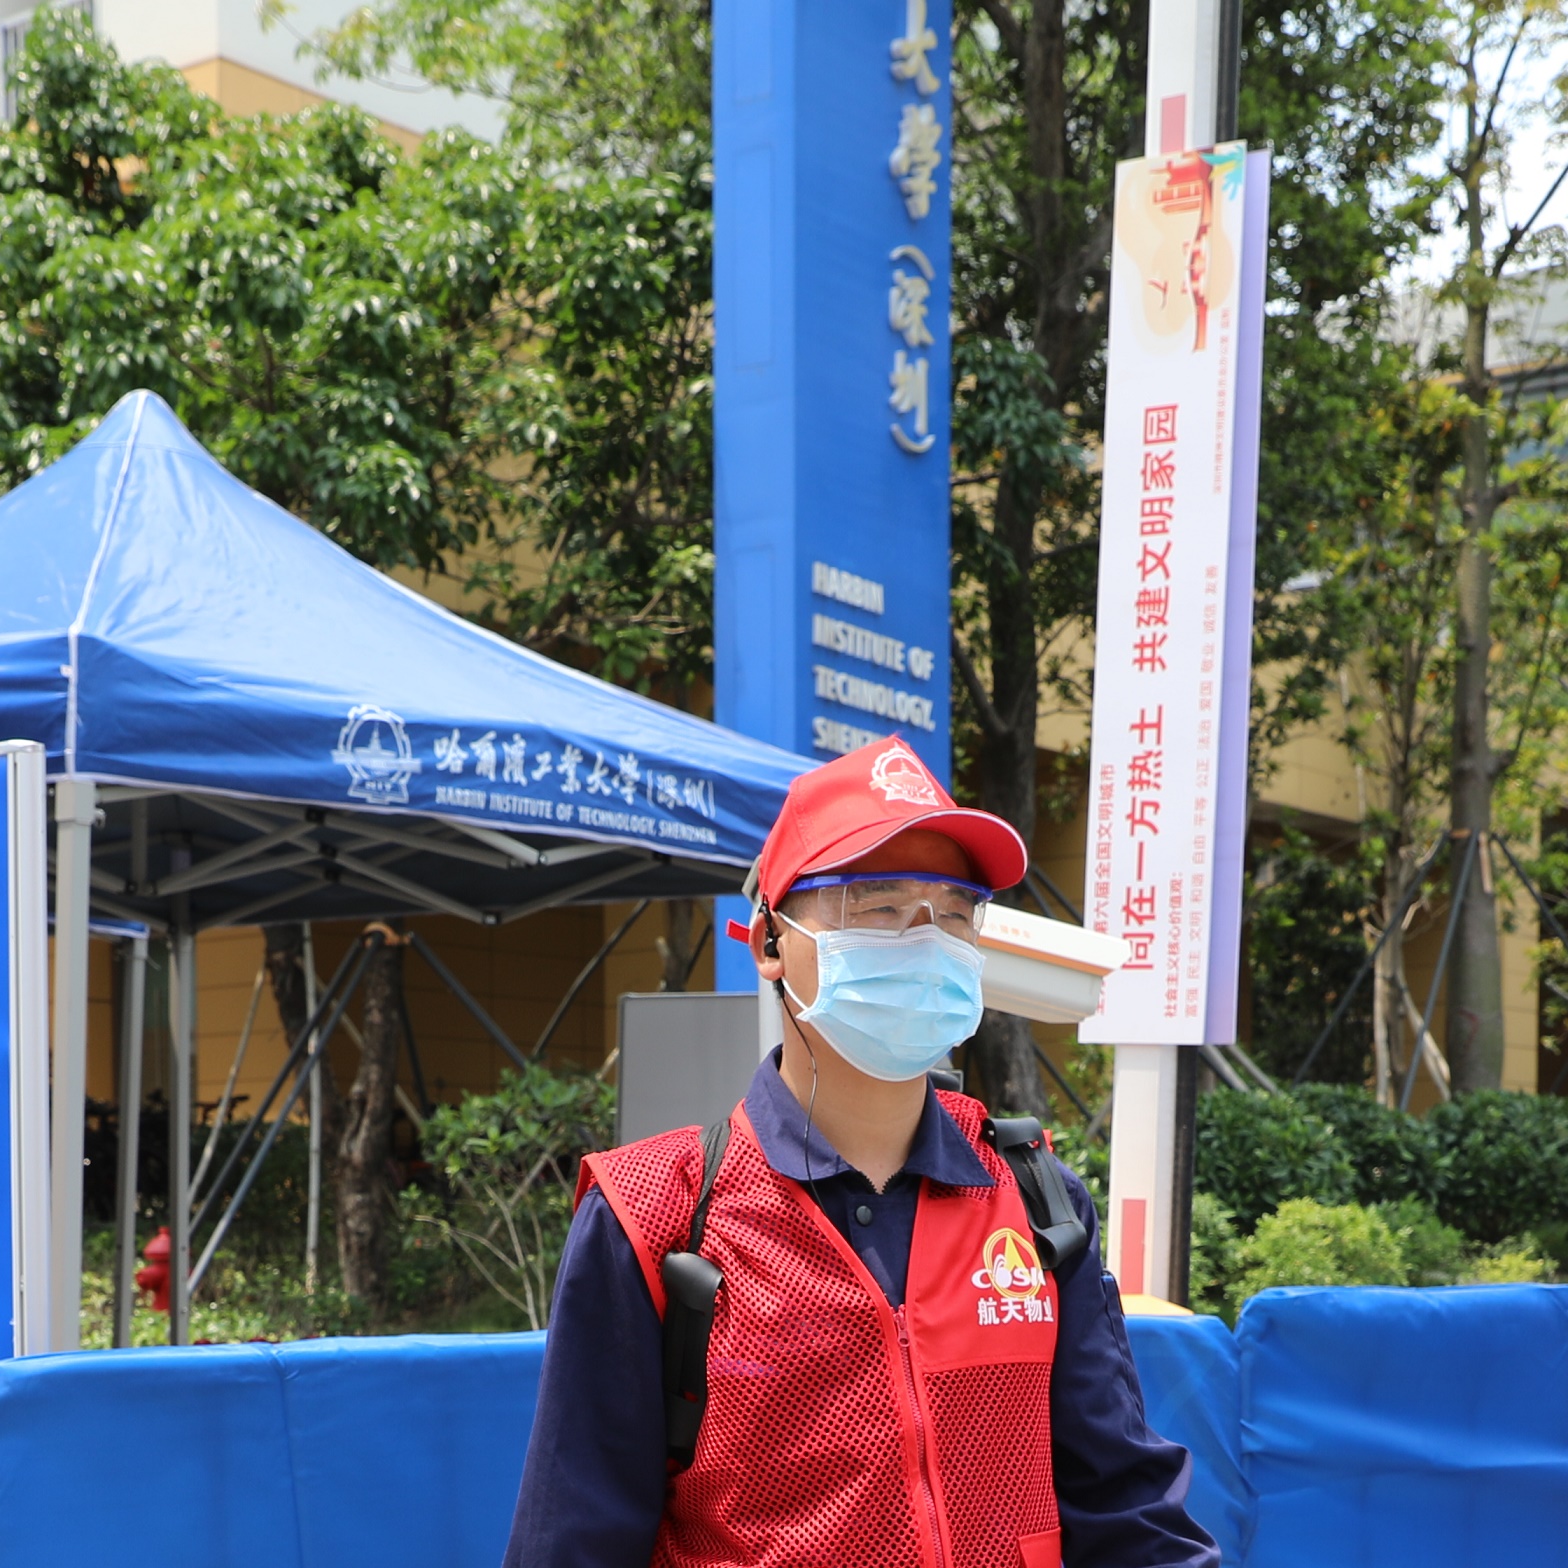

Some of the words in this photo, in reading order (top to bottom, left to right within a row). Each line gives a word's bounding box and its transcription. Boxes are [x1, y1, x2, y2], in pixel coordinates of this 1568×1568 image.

[1132, 404, 1178, 672] 共建文明家园
[812, 561, 885, 615] HARBIN
[812, 613, 905, 672] INSTITUTE
[907, 647, 934, 680] OF
[813, 665, 935, 732] TECHNOLOGY,
[1196, 759, 1210, 788] 公正
[435, 786, 486, 809] HARBIN
[489, 793, 554, 820] INSTITUTE
[556, 801, 574, 821] OF
[578, 805, 657, 836] TECHNOLOGY,
[1121, 703, 1164, 969] 同在一方热土
[1194, 797, 1208, 827] 平等
[1192, 835, 1206, 864] 自由
[1094, 764, 1116, 1015] 第六届全国文明城市
[1191, 873, 1204, 903] 和谐
[1189, 910, 1203, 941] 文明
[1187, 950, 1200, 980] 民主
